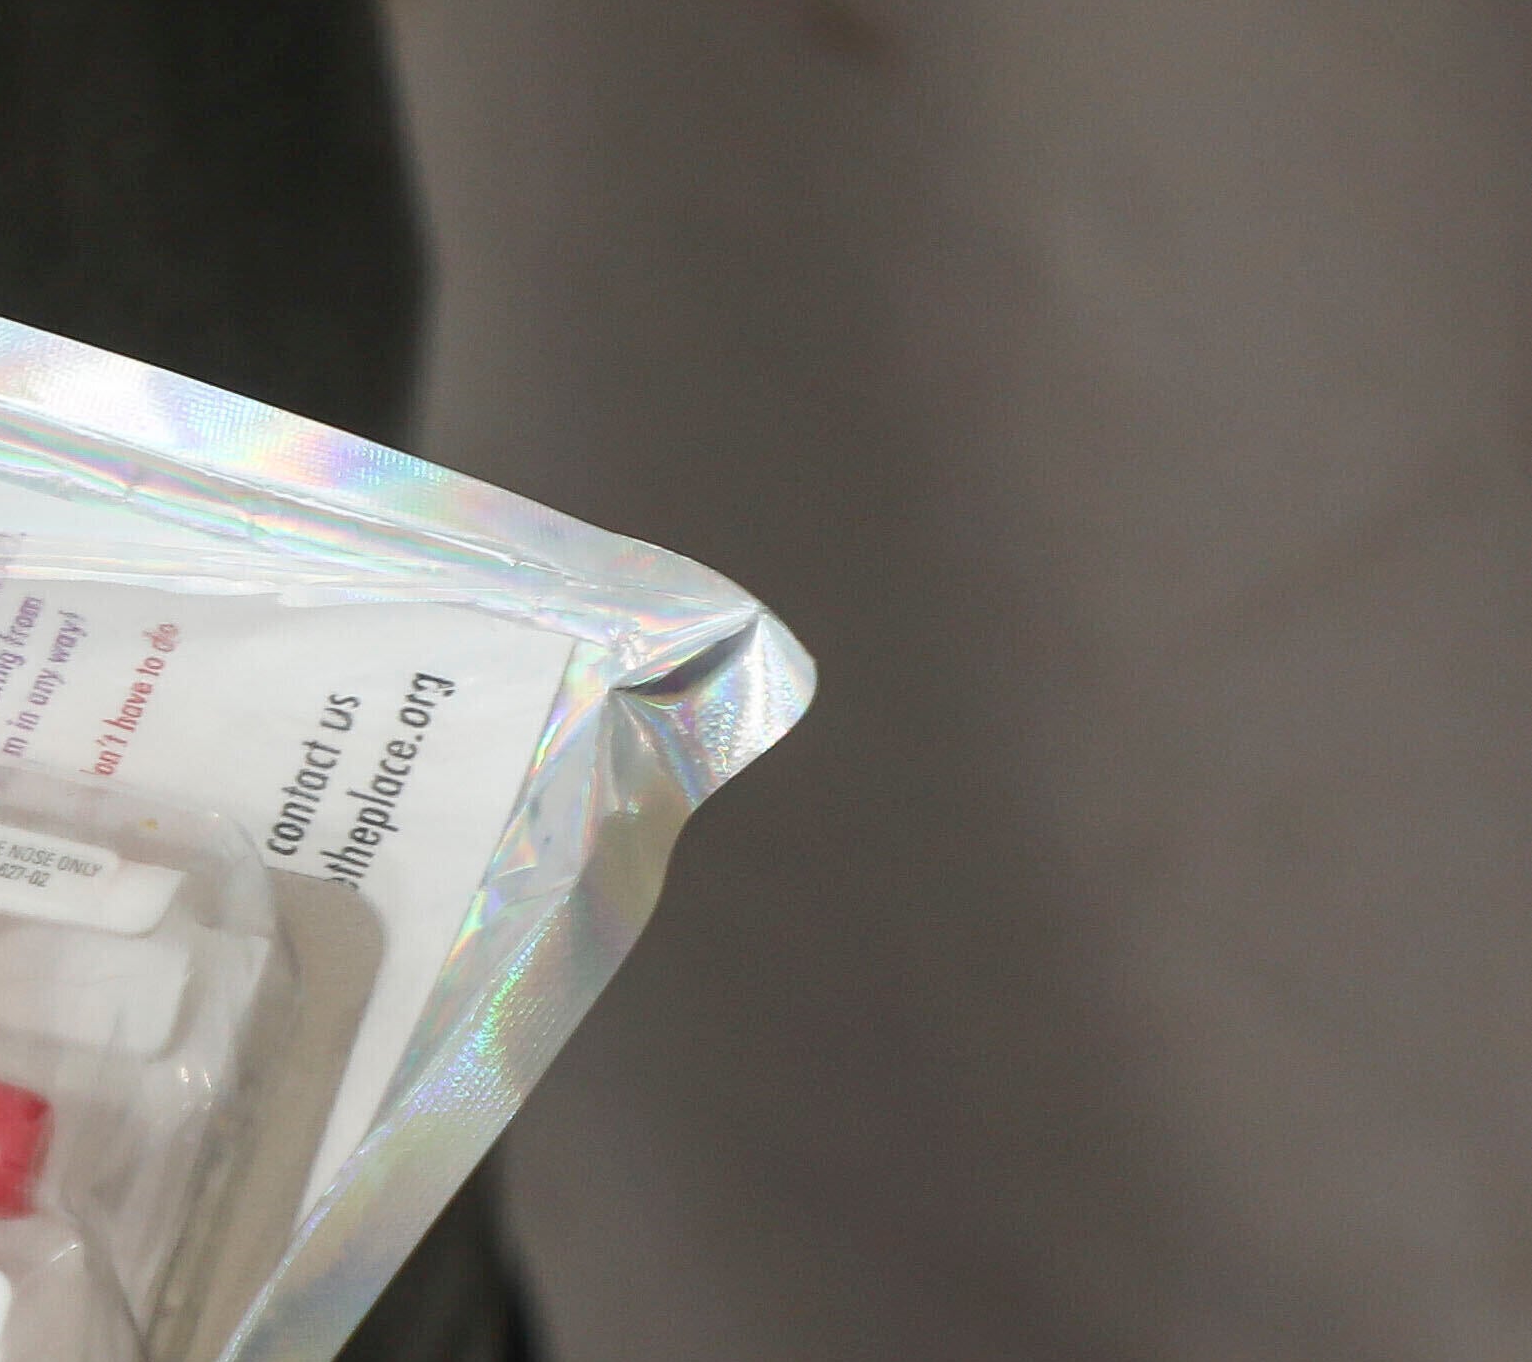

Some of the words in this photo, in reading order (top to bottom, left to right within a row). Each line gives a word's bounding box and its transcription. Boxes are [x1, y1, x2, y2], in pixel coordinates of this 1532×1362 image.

[7, 712, 41, 731] in
[28, 668, 65, 706] any
[103, 681, 154, 732] have
[135, 656, 166, 677] to
[267, 740, 342, 856] contact
[319, 693, 361, 732] us
[8, 844, 56, 868] NOSE
[57, 855, 103, 878] ONLY
